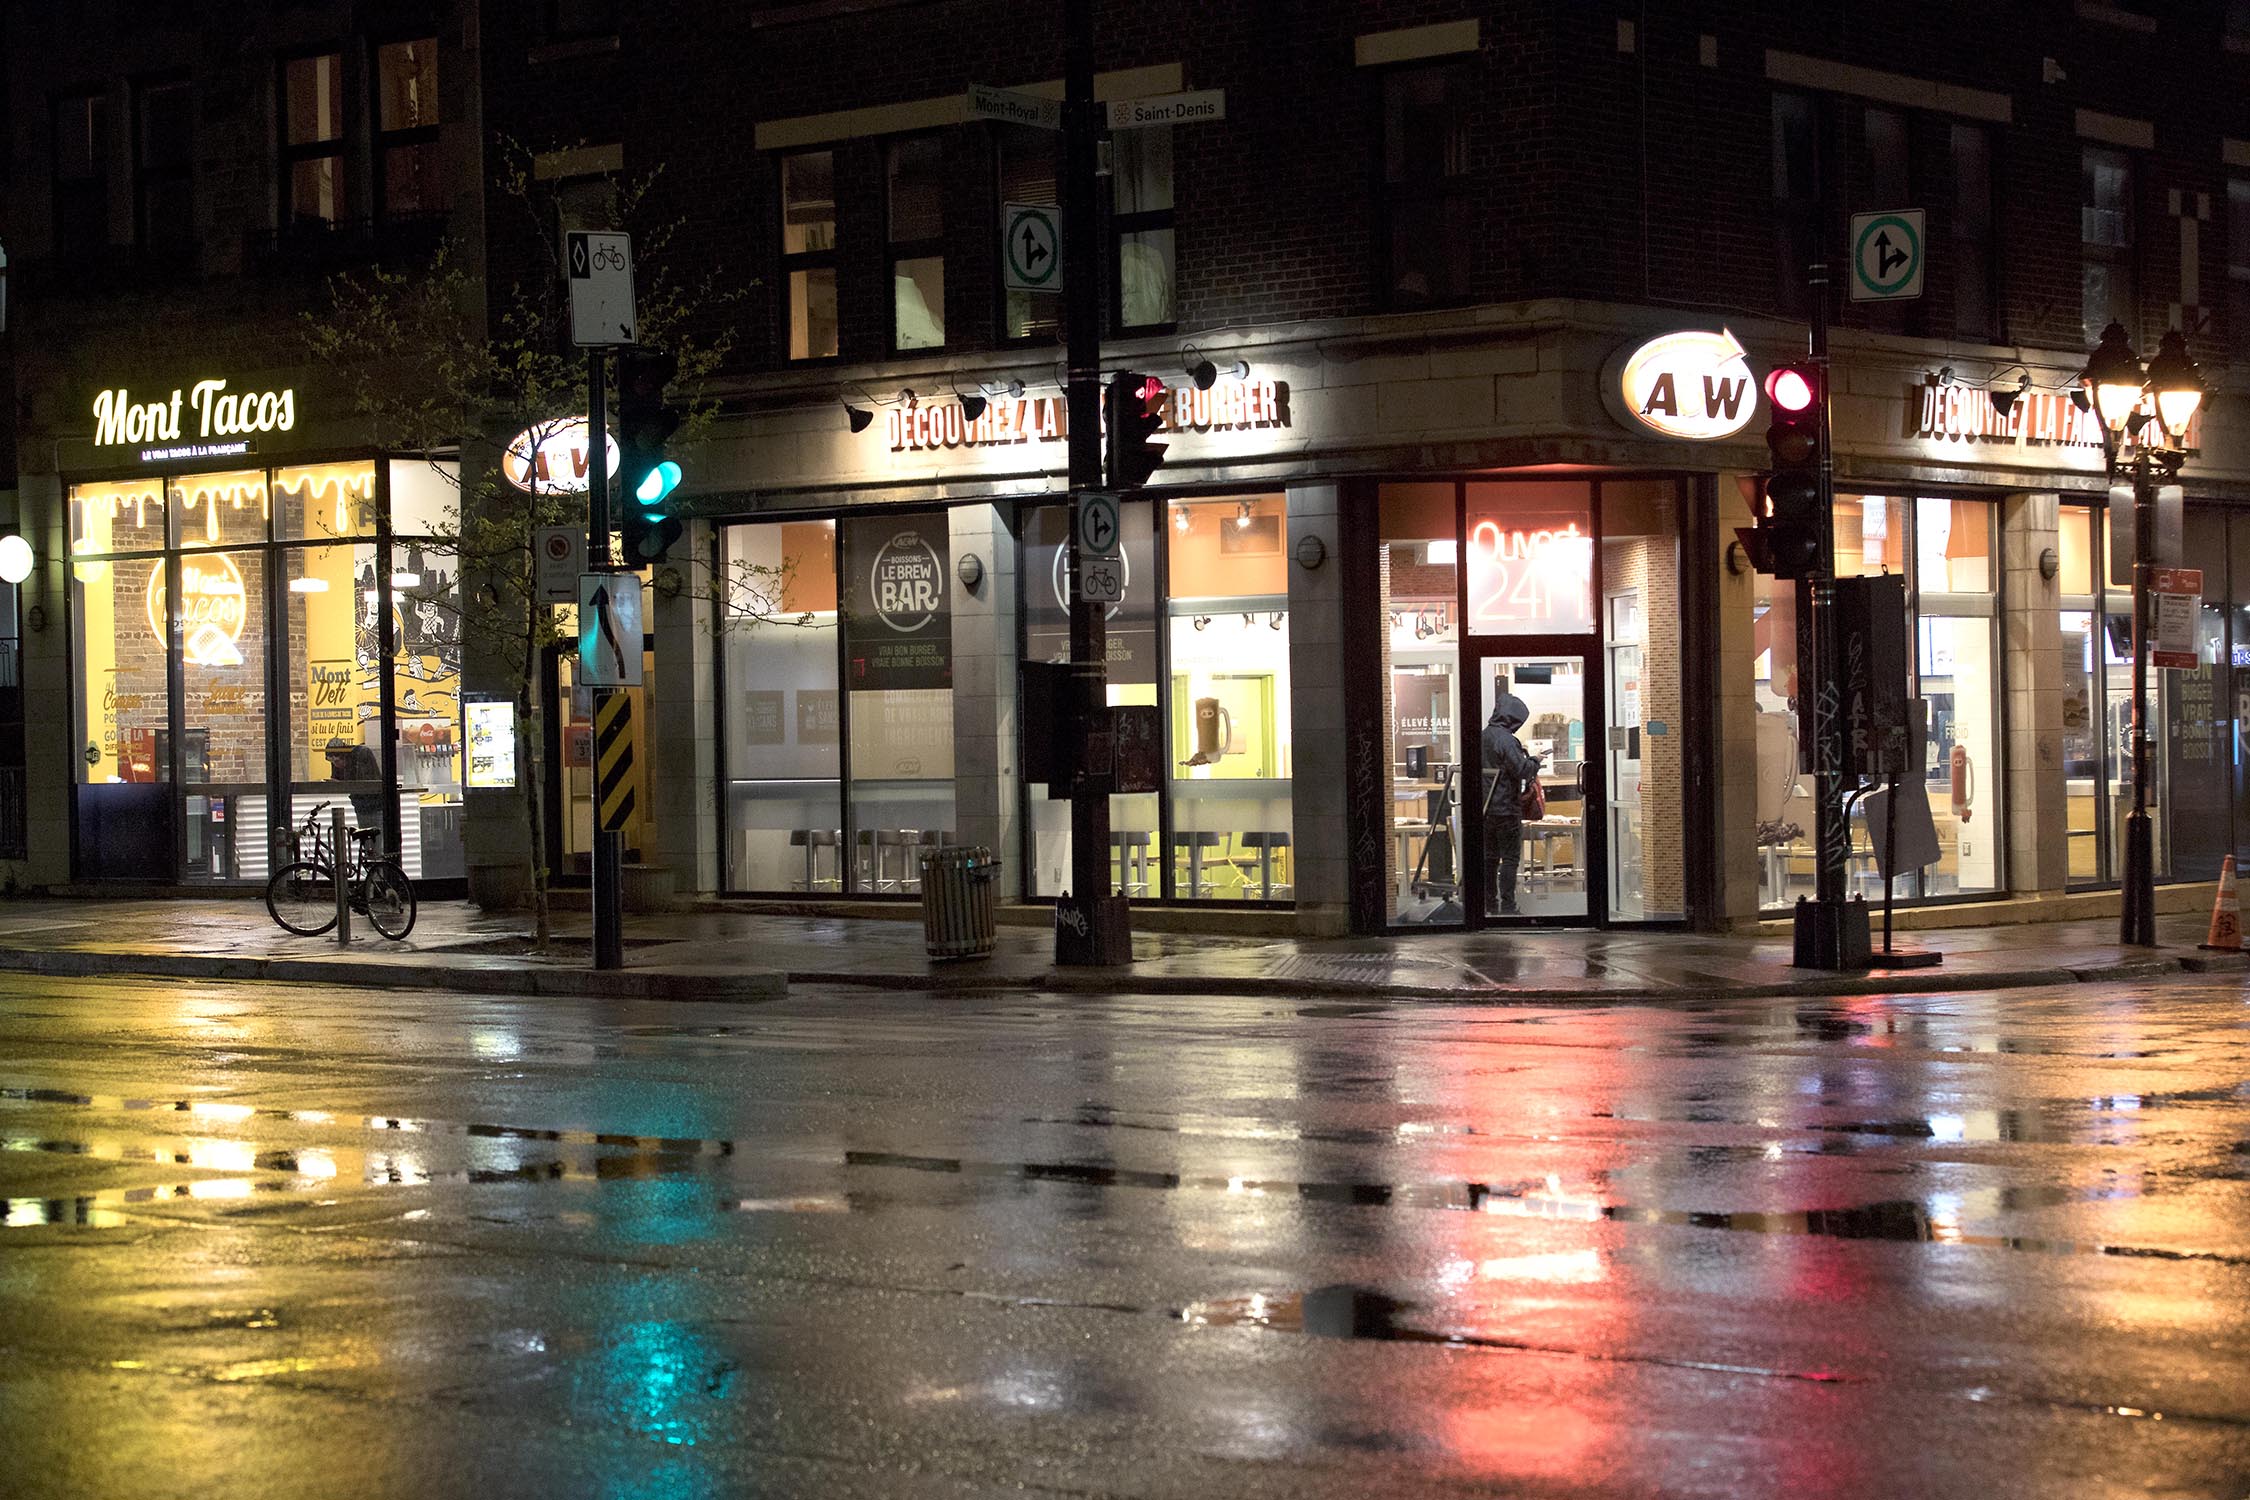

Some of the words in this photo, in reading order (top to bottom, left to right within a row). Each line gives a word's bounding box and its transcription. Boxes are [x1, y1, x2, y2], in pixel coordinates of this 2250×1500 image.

[975, 95, 1039, 120] Mont-Royal
[1134, 100, 1215, 122] Saint-Denis
[1176, 379, 1281, 428] BURGER
[1640, 372, 1748, 421] AW
[92, 388, 184, 447] Mont
[190, 378, 295, 438] Tacos
[2035, 393, 2058, 440] LA
[520, 446, 613, 483] AW
[890, 554, 923, 564] BOISSONS
[881, 565, 896, 581] LE
[897, 563, 932, 580] BREW
[881, 579, 939, 613] BAR
[894, 645, 909, 656] BON
[915, 654, 945, 667] BOISSON
[310, 665, 352, 685] Mont
[1401, 716, 1428, 728] ÉLEVÉ
[2182, 703, 2214, 721] VRAIE
[133, 728, 144, 741] LA
[334, 721, 355, 738] finis
